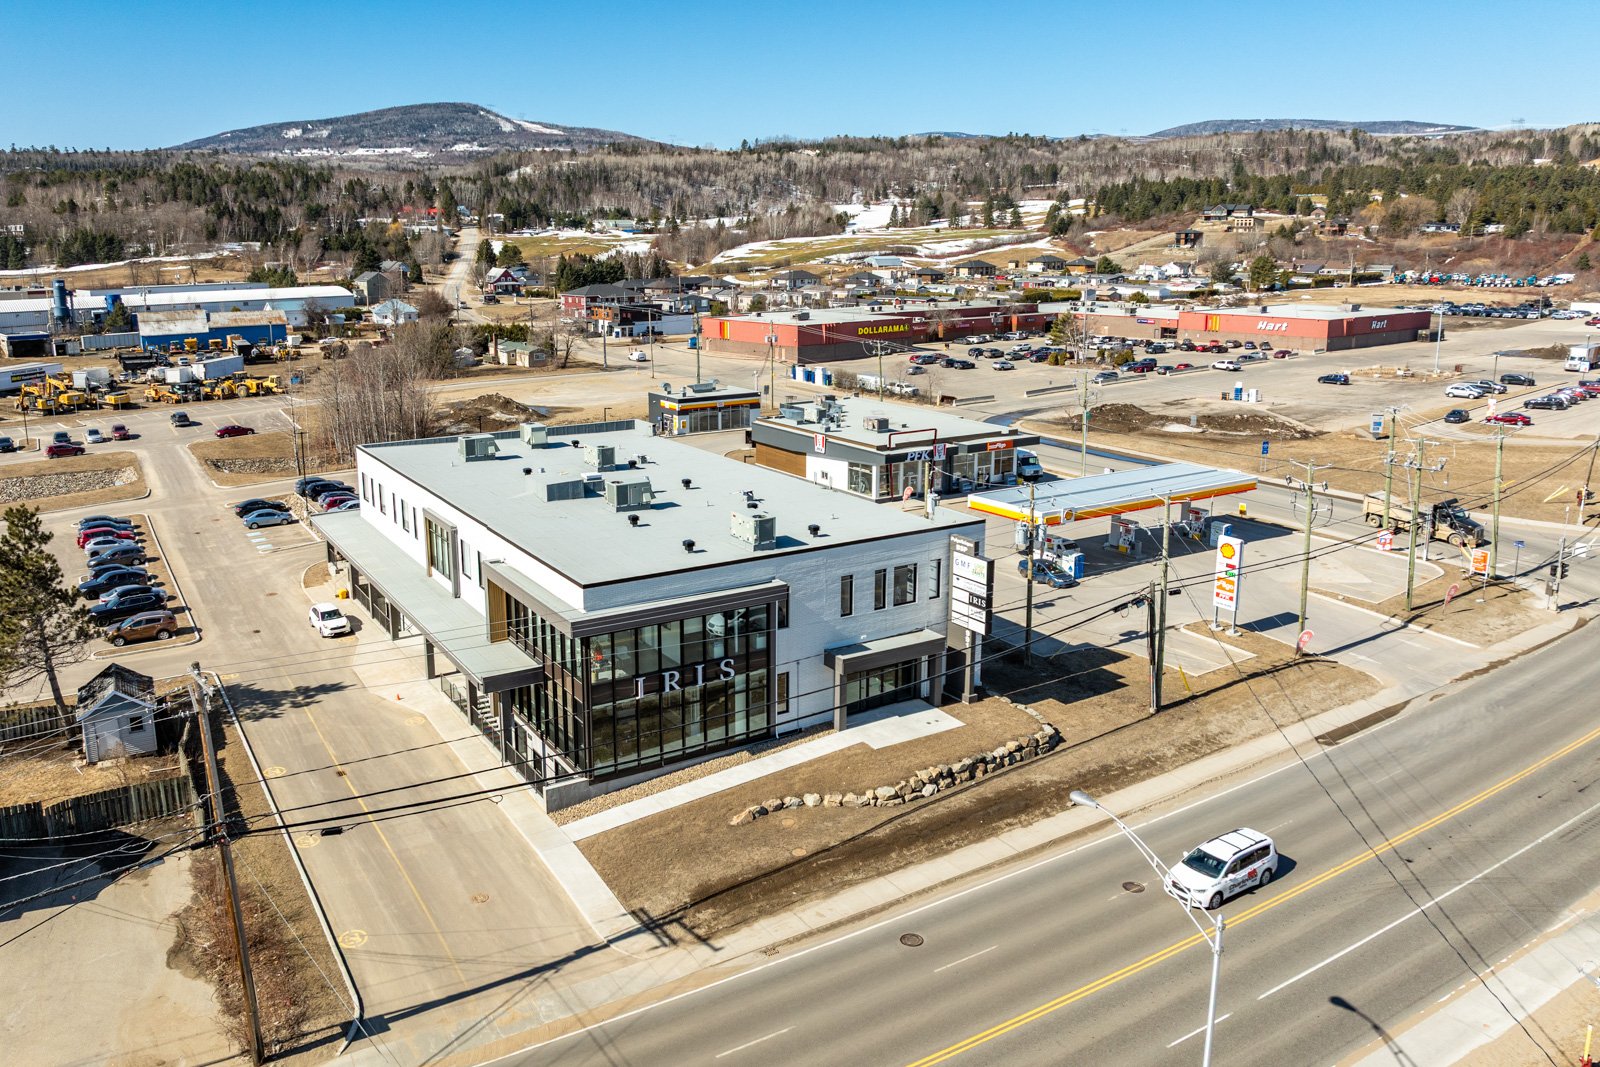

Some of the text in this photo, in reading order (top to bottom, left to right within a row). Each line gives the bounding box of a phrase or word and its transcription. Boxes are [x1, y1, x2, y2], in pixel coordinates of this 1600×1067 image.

[857, 324, 904, 335] DOLLARAMA
[1257, 320, 1288, 331] Hart
[1371, 319, 1387, 329] Hart
[906, 450, 931, 461] PFK
[969, 595, 986, 607] IRIS
[634, 658, 736, 700] IRIS
